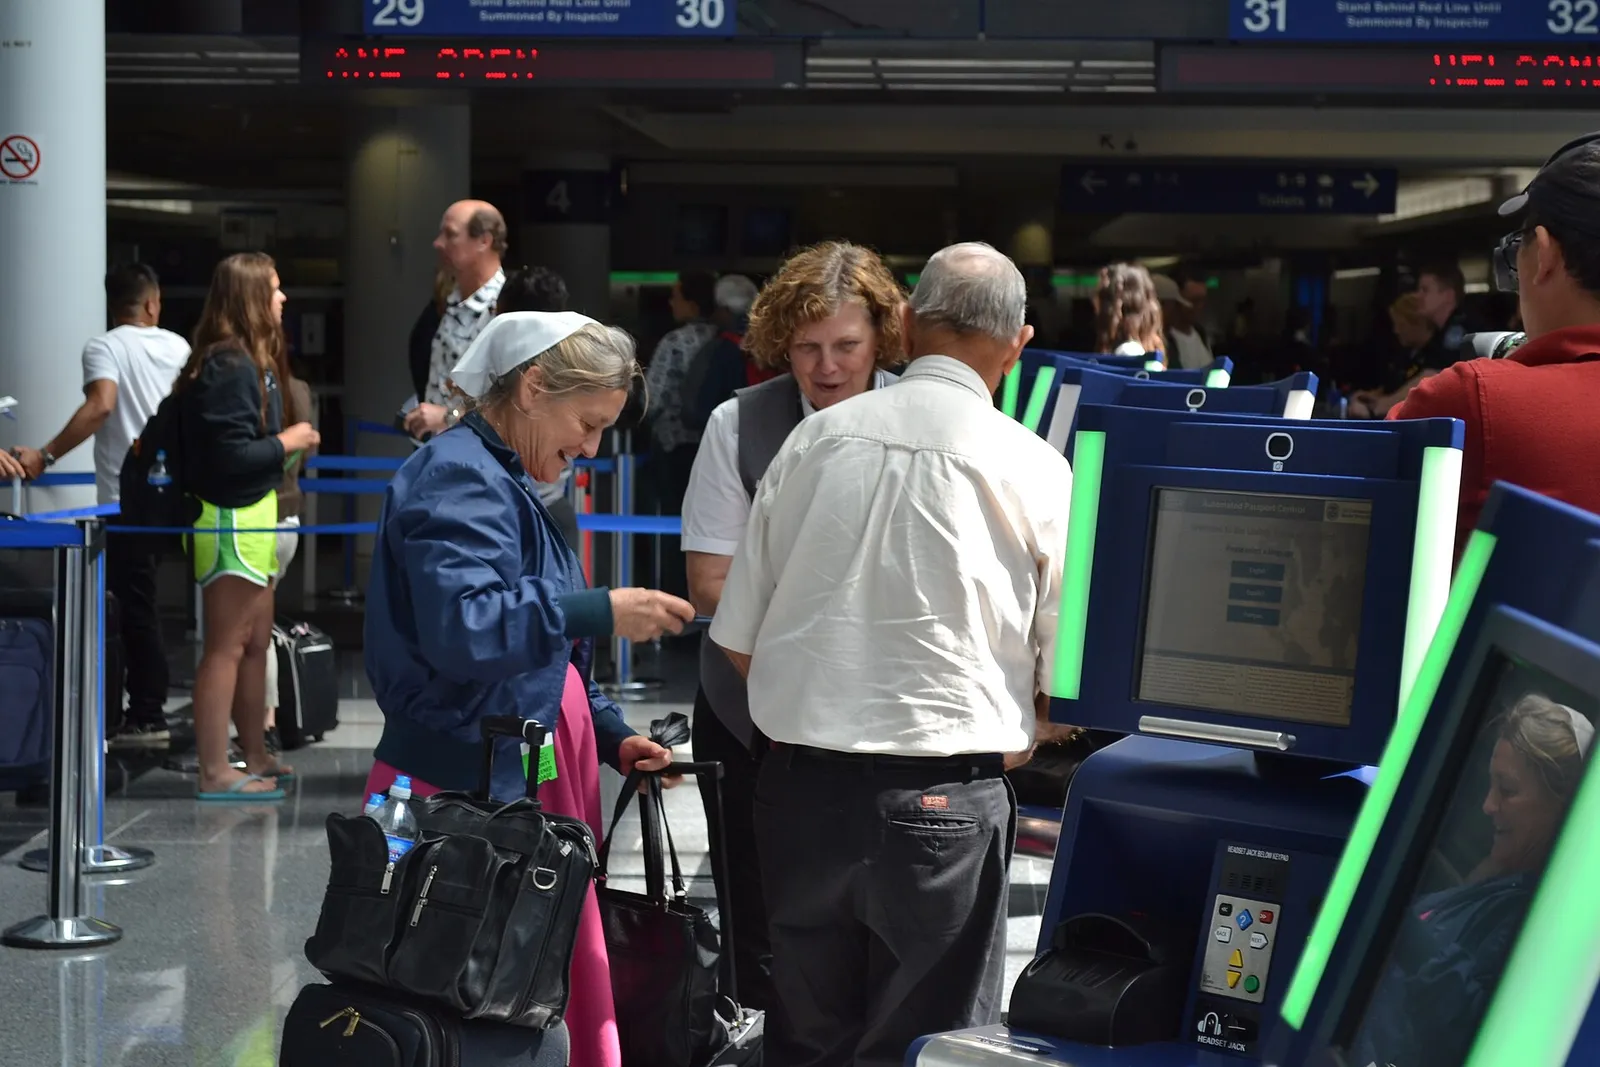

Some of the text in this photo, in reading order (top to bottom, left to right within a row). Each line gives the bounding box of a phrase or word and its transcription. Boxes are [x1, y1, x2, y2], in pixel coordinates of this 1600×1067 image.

[372, 0, 424, 26] 29
[676, 0, 725, 28] 30
[1243, 0, 1287, 32] 31
[1374, 2, 1416, 13] Behind
[1445, 2, 1470, 13] Line
[479, 10, 620, 23] Summoned By Inspector
[1346, 15, 1490, 30] Summoned By Inspector
[1547, 0, 1599, 34] 32
[1227, 845, 1246, 855] HEADSET
[1197, 1035, 1246, 1052] HEADSET JACK
